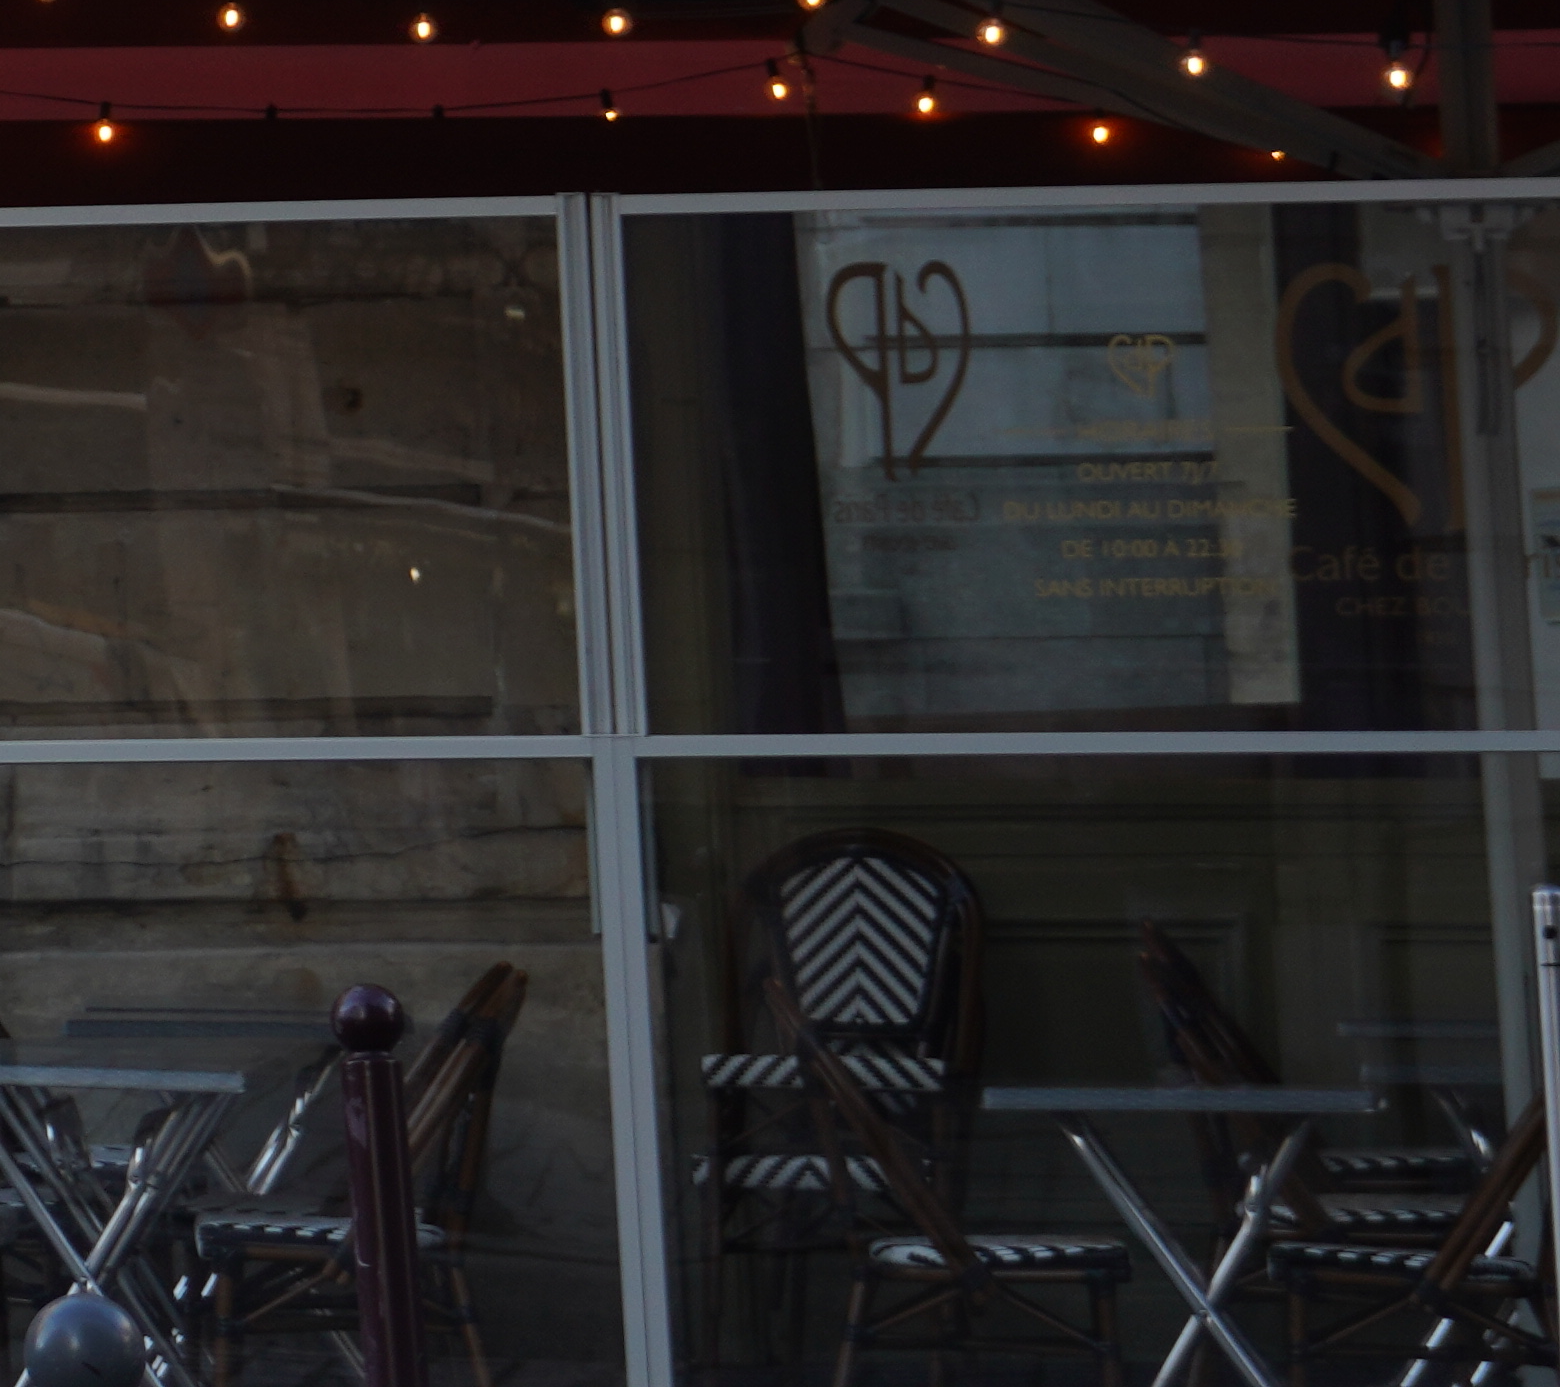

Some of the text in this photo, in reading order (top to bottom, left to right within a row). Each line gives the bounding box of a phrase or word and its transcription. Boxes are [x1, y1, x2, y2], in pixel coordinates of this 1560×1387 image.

[1076, 461, 1173, 483] OUVERT
[1002, 498, 1298, 520] DU LUNDI AU DIMANCHE
[1061, 539, 1094, 558] DE
[1288, 543, 1451, 583] Café de
[1034, 577, 1094, 598] SANS
[1334, 596, 1406, 617] CHEZ
